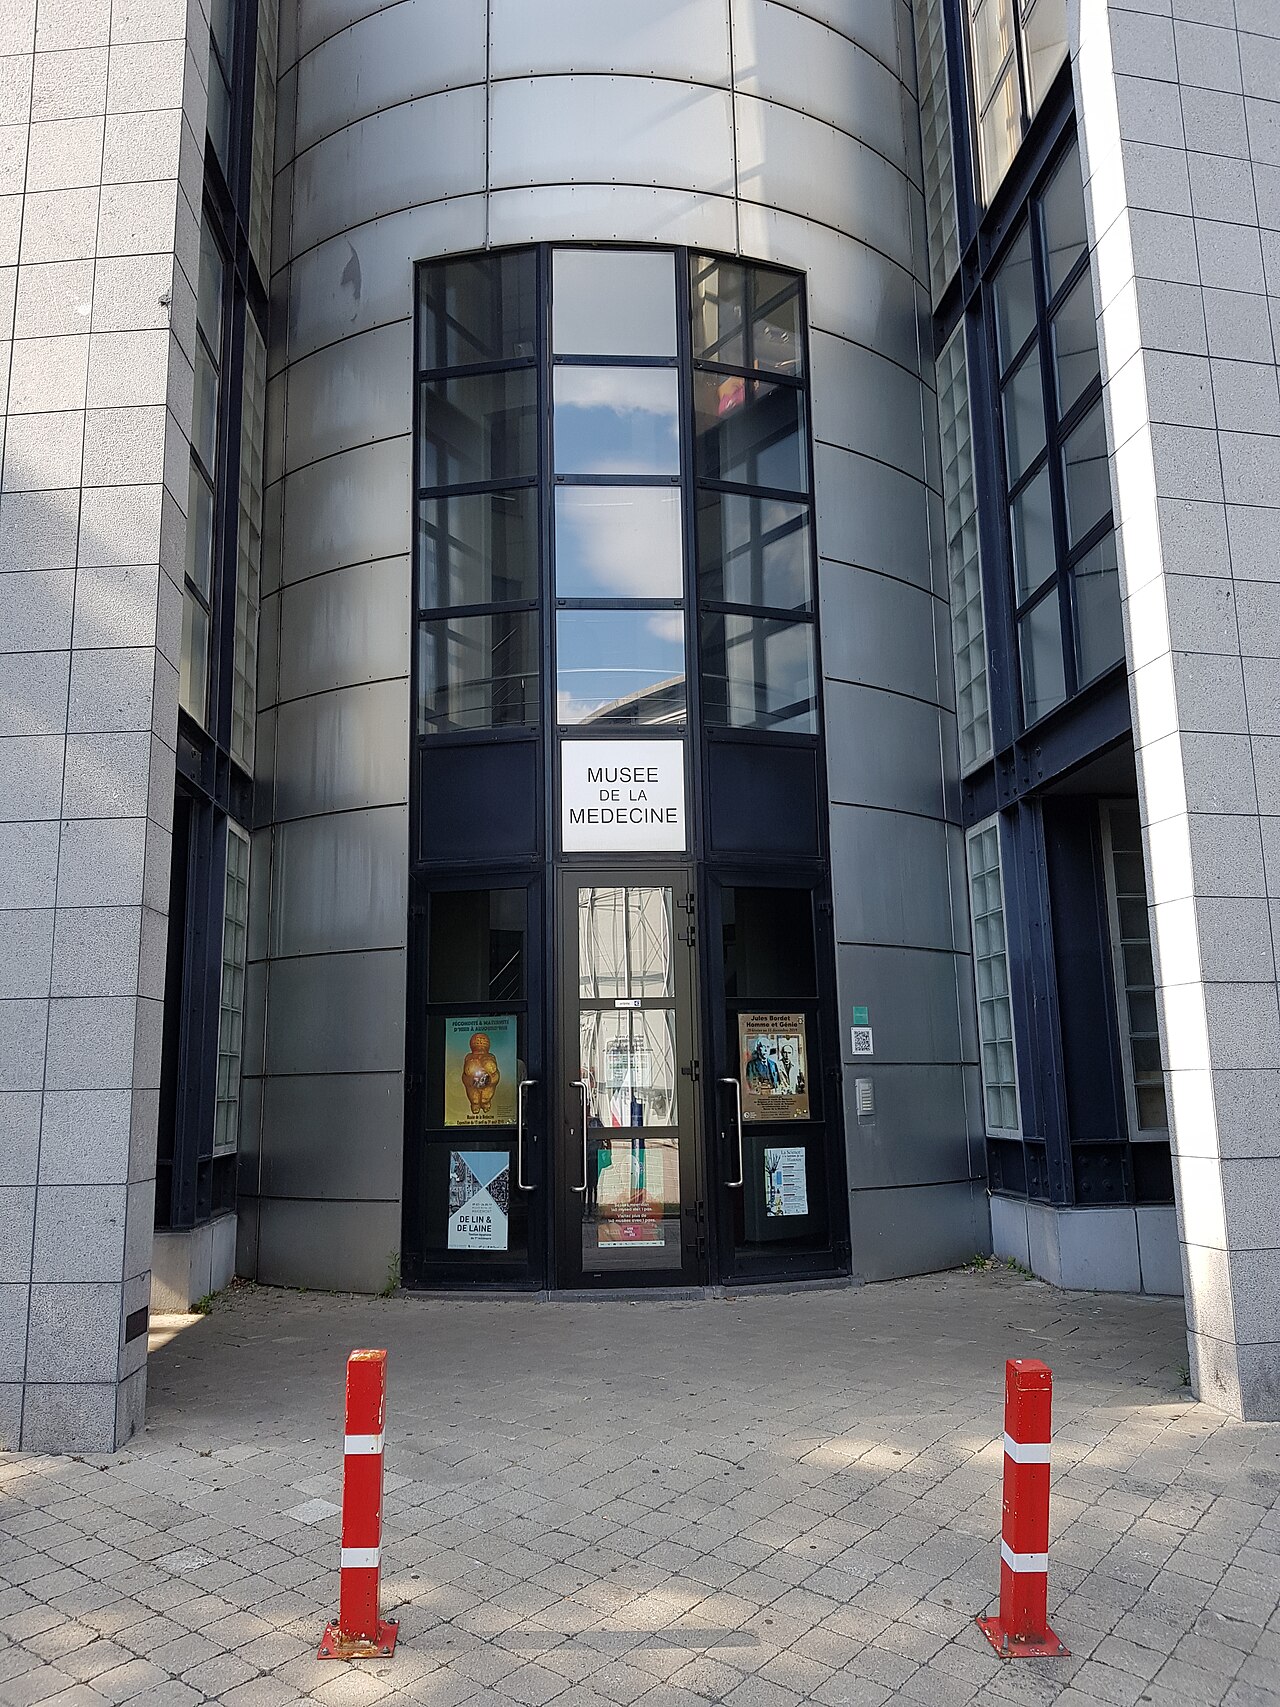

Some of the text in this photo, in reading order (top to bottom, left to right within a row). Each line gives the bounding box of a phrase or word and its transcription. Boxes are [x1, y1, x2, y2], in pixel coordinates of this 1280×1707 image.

[588, 767, 658, 783] MUSEE
[600, 790, 647, 801] DE LA
[569, 808, 678, 824] MEDECINE
